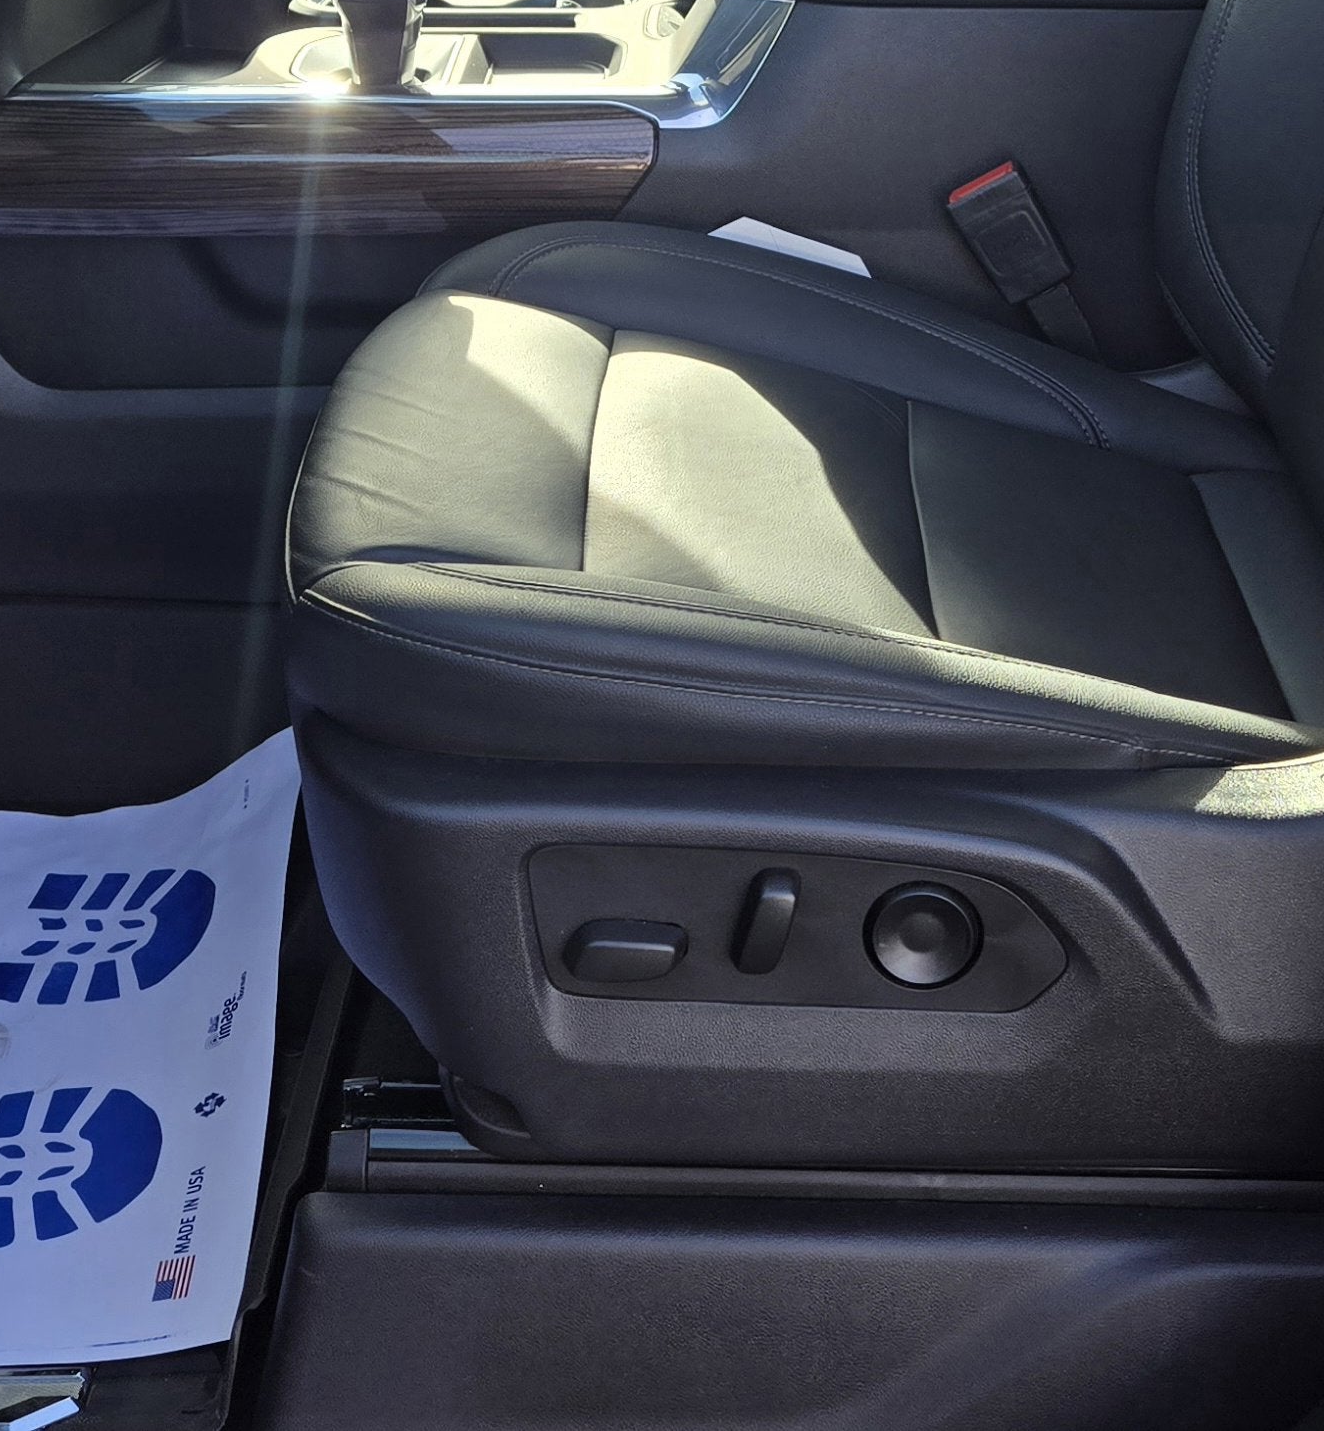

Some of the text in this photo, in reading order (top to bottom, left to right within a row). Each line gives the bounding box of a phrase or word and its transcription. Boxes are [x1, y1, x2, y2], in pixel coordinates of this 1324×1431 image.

[174, 1165, 206, 1255] MADE IN USA
